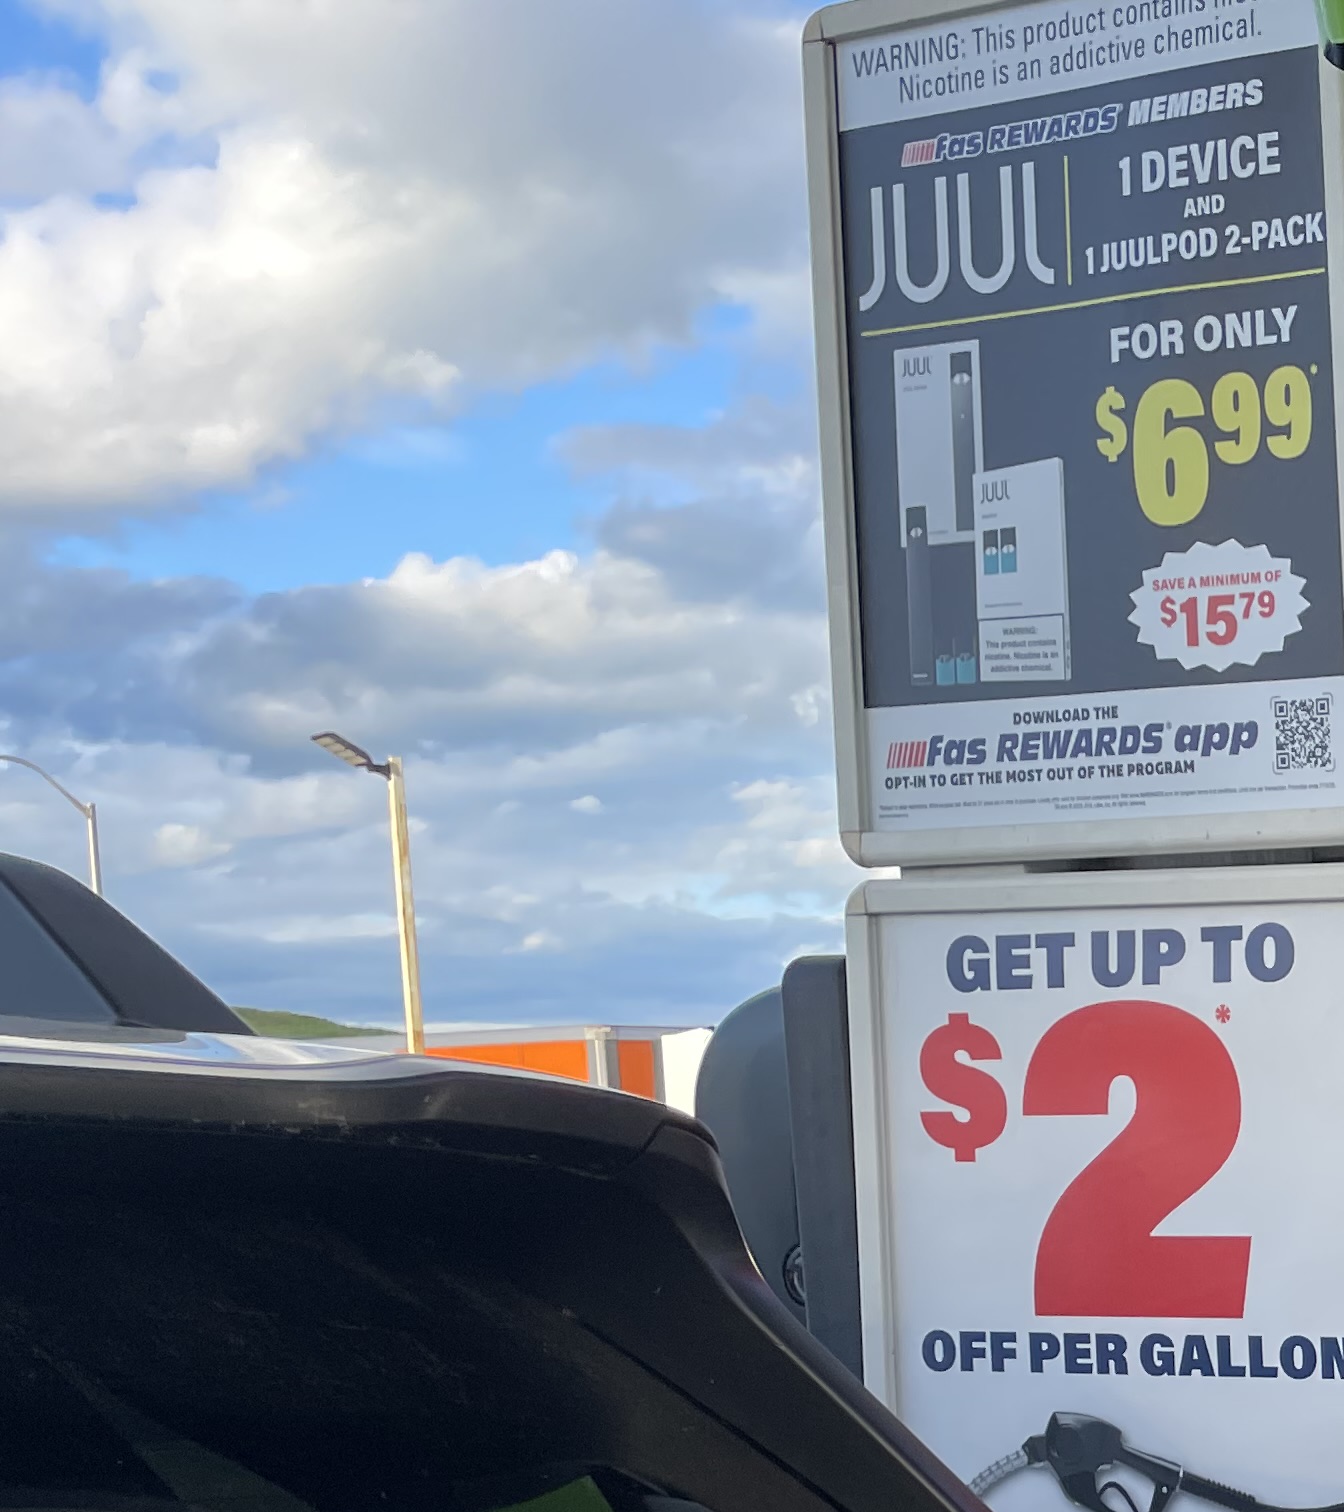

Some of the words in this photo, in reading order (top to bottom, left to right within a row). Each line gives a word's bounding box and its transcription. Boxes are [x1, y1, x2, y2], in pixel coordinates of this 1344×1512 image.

[852, 33, 966, 78] WARNING:
[973, 25, 1015, 56] This
[1022, 8, 1105, 49] product
[899, 66, 985, 102] Nicotine
[992, 60, 1009, 86] is
[1017, 58, 1042, 81] an
[1049, 35, 1145, 75] addictive
[1154, 9, 1262, 54] chemical.
[987, 104, 1122, 154] REWARDS
[1128, 79, 1264, 127] MEMBERS
[1118, 157, 1130, 195] 1
[1141, 132, 1282, 191] DEVICE
[1183, 194, 1225, 217] AND
[859, 162, 1055, 311] JUUL
[1085, 247, 1095, 275] 1
[1099, 226, 1217, 273] JUULPOD
[1225, 212, 1324, 257] 2-PACK
[1110, 320, 1184, 363] FOR
[1193, 306, 1297, 351] ONLY
[902, 356, 932, 377] JUUL
[981, 479, 1010, 504] JUUL
[1152, 577, 1184, 591] SAVE
[1188, 576, 1197, 589] A
[1200, 571, 1261, 588] MINIMUM
[1265, 569, 1282, 582] OF
[1013, 707, 1090, 725] DOWNLOAD
[1093, 705, 1119, 720] THE
[996, 723, 1164, 762] REWARDS
[1174, 720, 1259, 757] app
[885, 775, 927, 790] OPT-IN
[929, 774, 946, 787] TO
[950, 772, 974, 786] GET
[977, 771, 1003, 785] THE
[1006, 768, 1043, 783] MOST
[1046, 767, 1073, 782] OUT
[1077, 766, 1095, 780] OF
[1097, 763, 1123, 778] THE
[1126, 760, 1195, 777] PROGRAM
[946, 932, 1075, 993] GET
[1091, 928, 1186, 988] UP
[1200, 922, 1295, 983] TO
[922, 1330, 1017, 1372] OFF
[1029, 1332, 1128, 1375] PER
